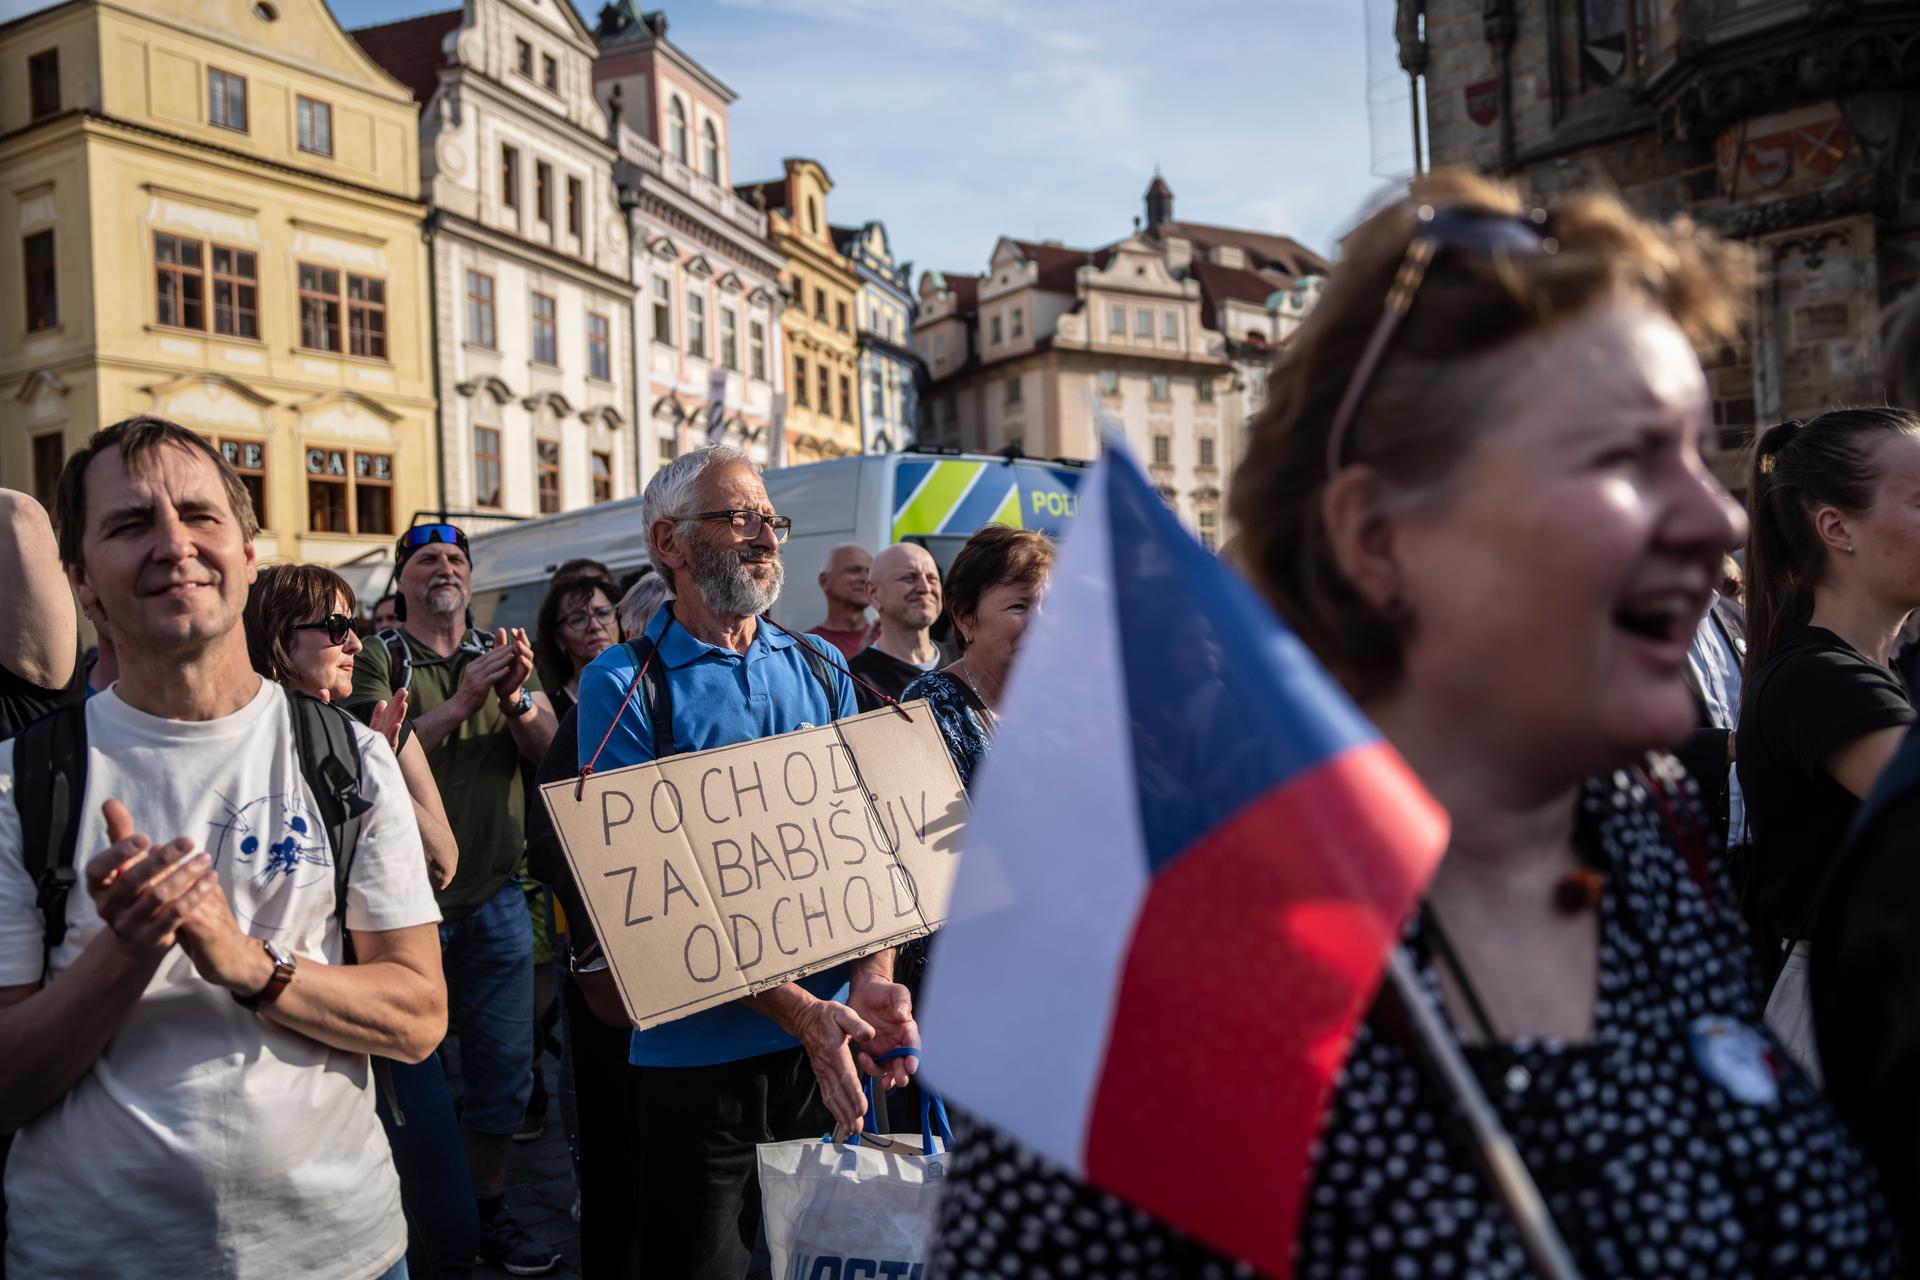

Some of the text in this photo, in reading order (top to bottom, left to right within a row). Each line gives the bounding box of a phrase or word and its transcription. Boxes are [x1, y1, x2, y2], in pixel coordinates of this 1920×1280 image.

[222, 441, 262, 468] FE
[1031, 490, 1079, 517] POLI
[601, 743, 861, 846] POCHOD
[604, 790, 926, 927] ZA BABIŠŮV
[684, 863, 919, 983] ODCHOD
